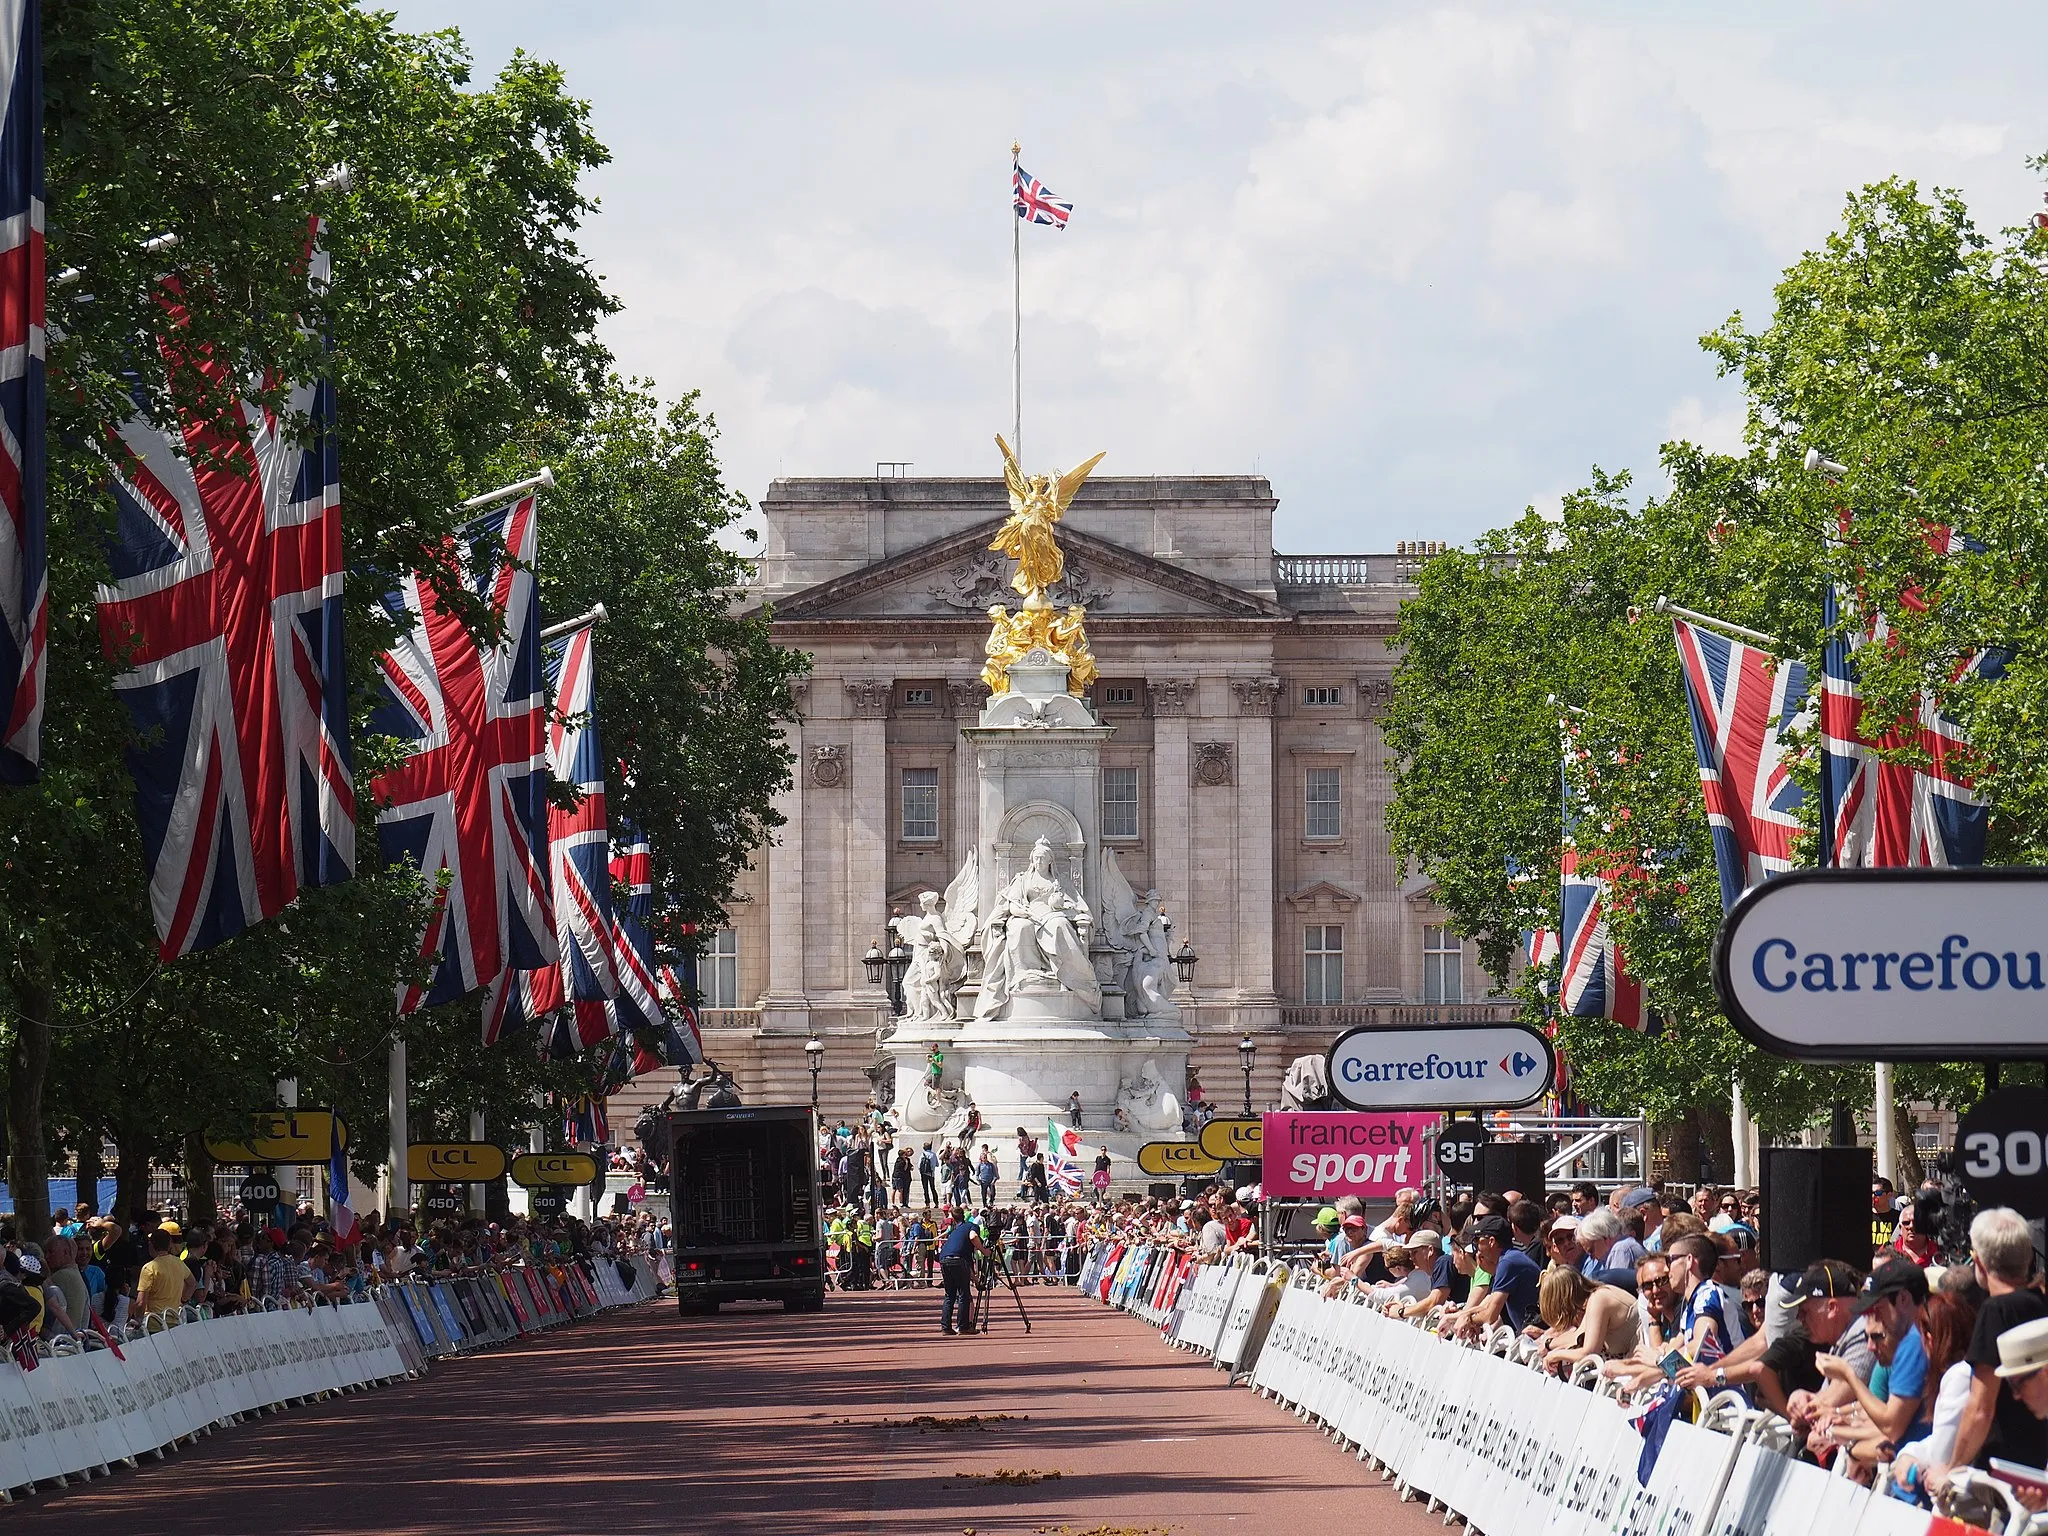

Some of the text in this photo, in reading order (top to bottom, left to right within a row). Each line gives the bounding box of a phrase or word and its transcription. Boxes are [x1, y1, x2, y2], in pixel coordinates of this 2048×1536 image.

[1751, 933, 2048, 993] Carrefou
[1341, 1053, 1488, 1083] Carrefour
[258, 1119, 309, 1139] CL
[1233, 1126, 1263, 1142] LC
[1288, 1118, 1415, 1146] francetv
[431, 1149, 477, 1165] LCL
[1165, 1148, 1201, 1160] LCL
[1440, 1141, 1483, 1163] 35
[1964, 1130, 2048, 1178] 30
[537, 1159, 574, 1172] LCL
[1289, 1146, 1412, 1191] sport
[241, 1185, 278, 1200] 400
[427, 1198, 455, 1209] 450
[534, 1197, 556, 1207] 500
